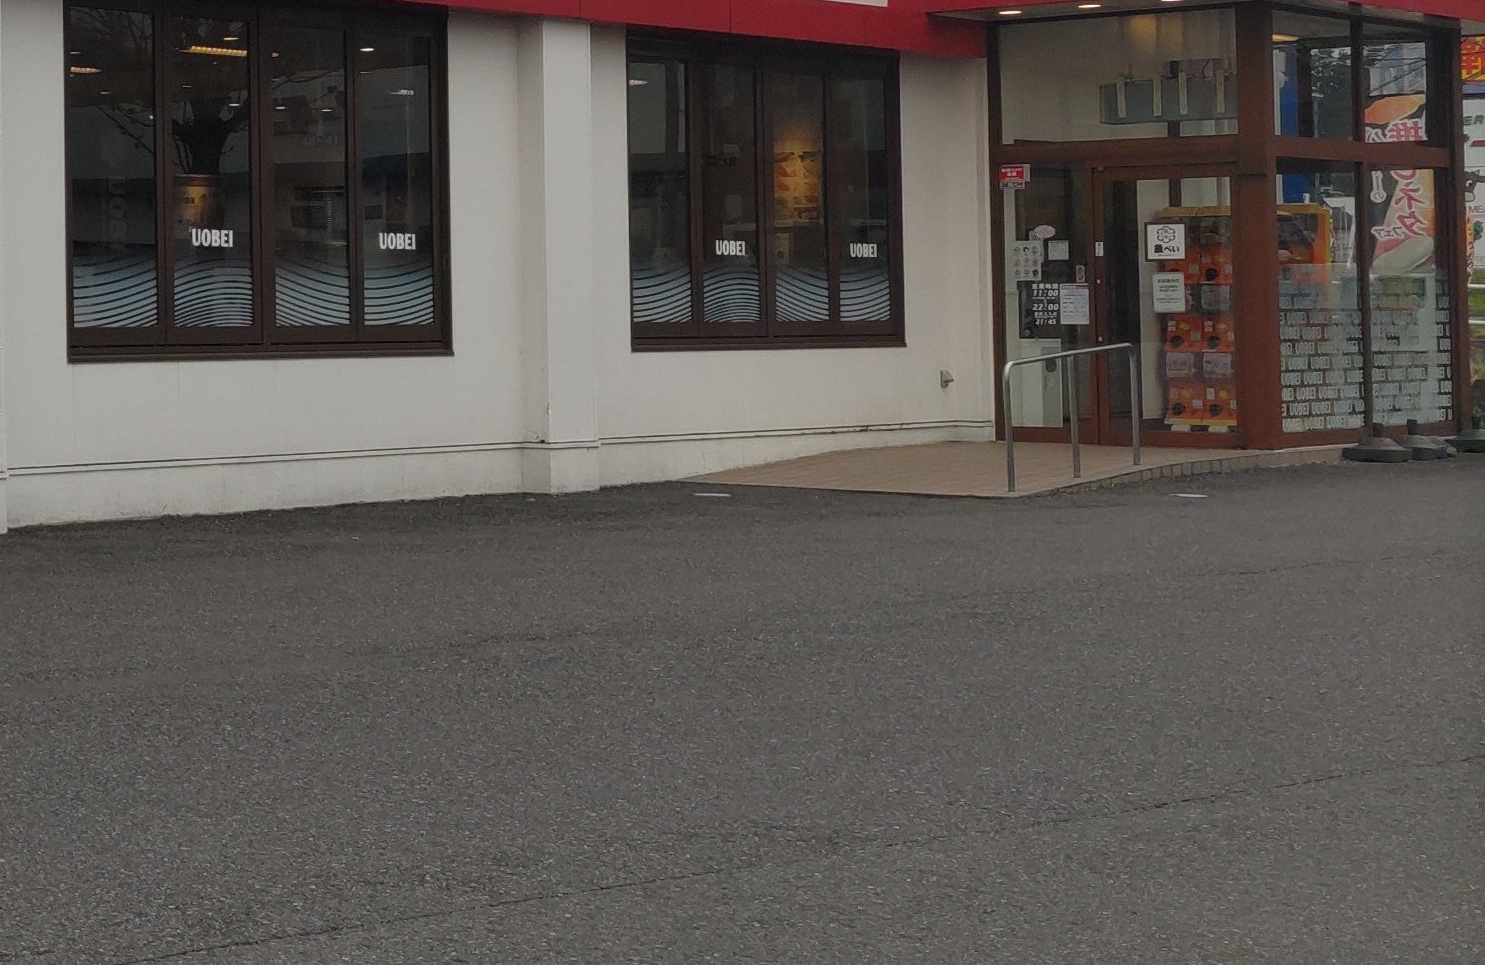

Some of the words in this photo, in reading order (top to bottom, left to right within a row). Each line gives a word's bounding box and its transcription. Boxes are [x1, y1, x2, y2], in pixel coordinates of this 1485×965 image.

[191, 228, 233, 248] UOBEI
[378, 232, 416, 250] UOBEI
[715, 239, 746, 256] UOBEI
[849, 242, 878, 258] UOBEI
